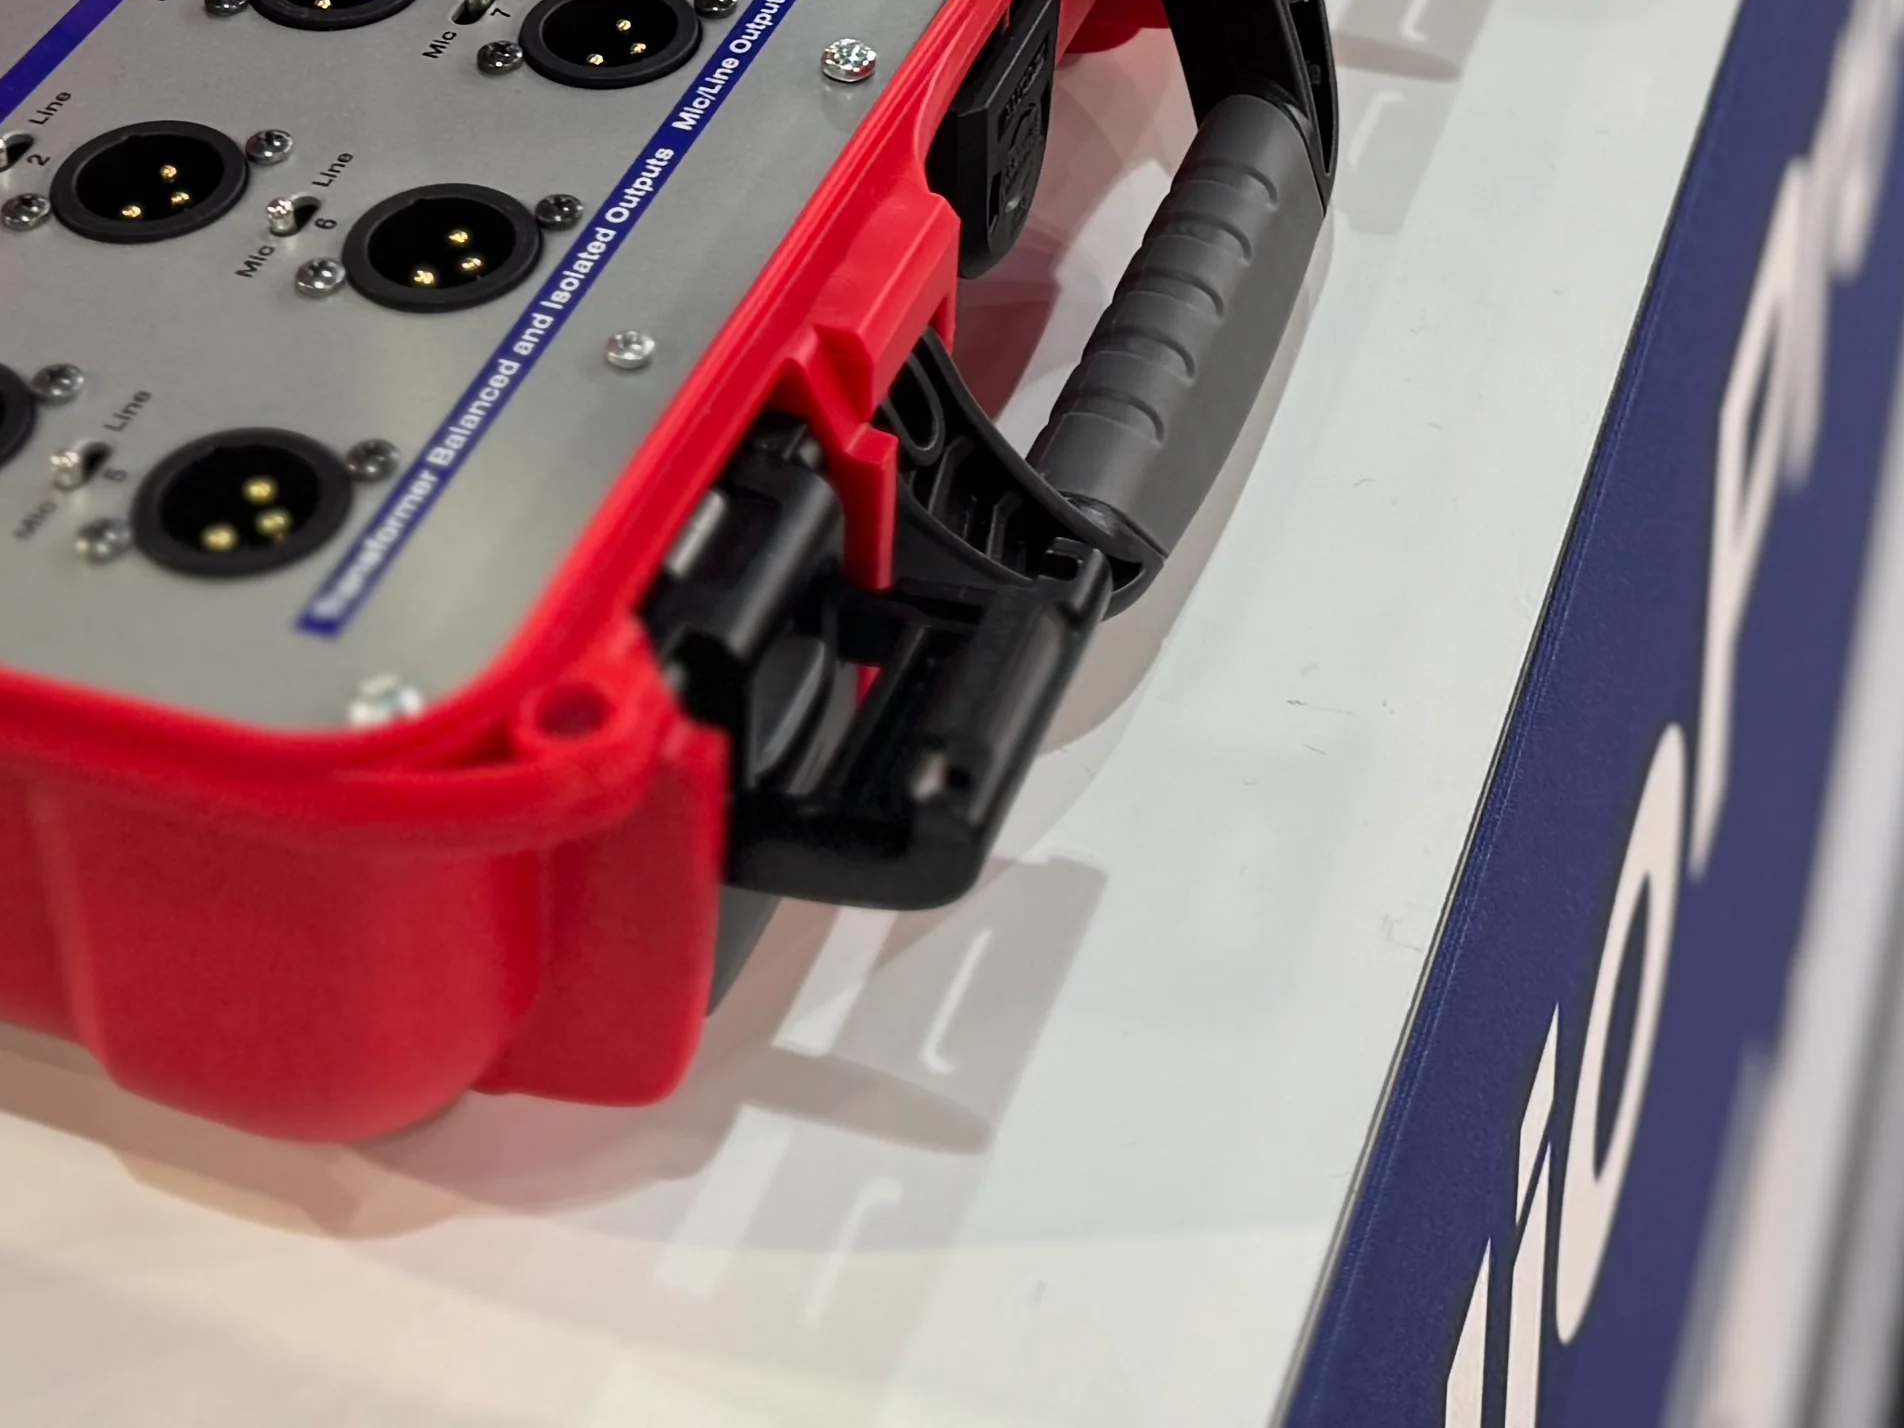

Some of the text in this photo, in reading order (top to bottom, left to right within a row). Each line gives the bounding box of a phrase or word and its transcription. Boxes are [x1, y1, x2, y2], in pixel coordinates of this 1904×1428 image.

[490, 7, 511, 19] 7
[422, 30, 457, 59] Mic
[28, 90, 72, 125] Line
[27, 153, 51, 167] 2
[312, 151, 354, 188] Line
[314, 217, 338, 230] 6
[234, 244, 276, 279] Mic
[427, 358, 522, 467] Balanced
[513, 312, 555, 356] and
[540, 227, 617, 310] Isolated
[605, 148, 675, 224] Outputs
[672, 58, 739, 132] Mic/Line
[102, 391, 151, 432] Line
[13, 500, 59, 540] Mic
